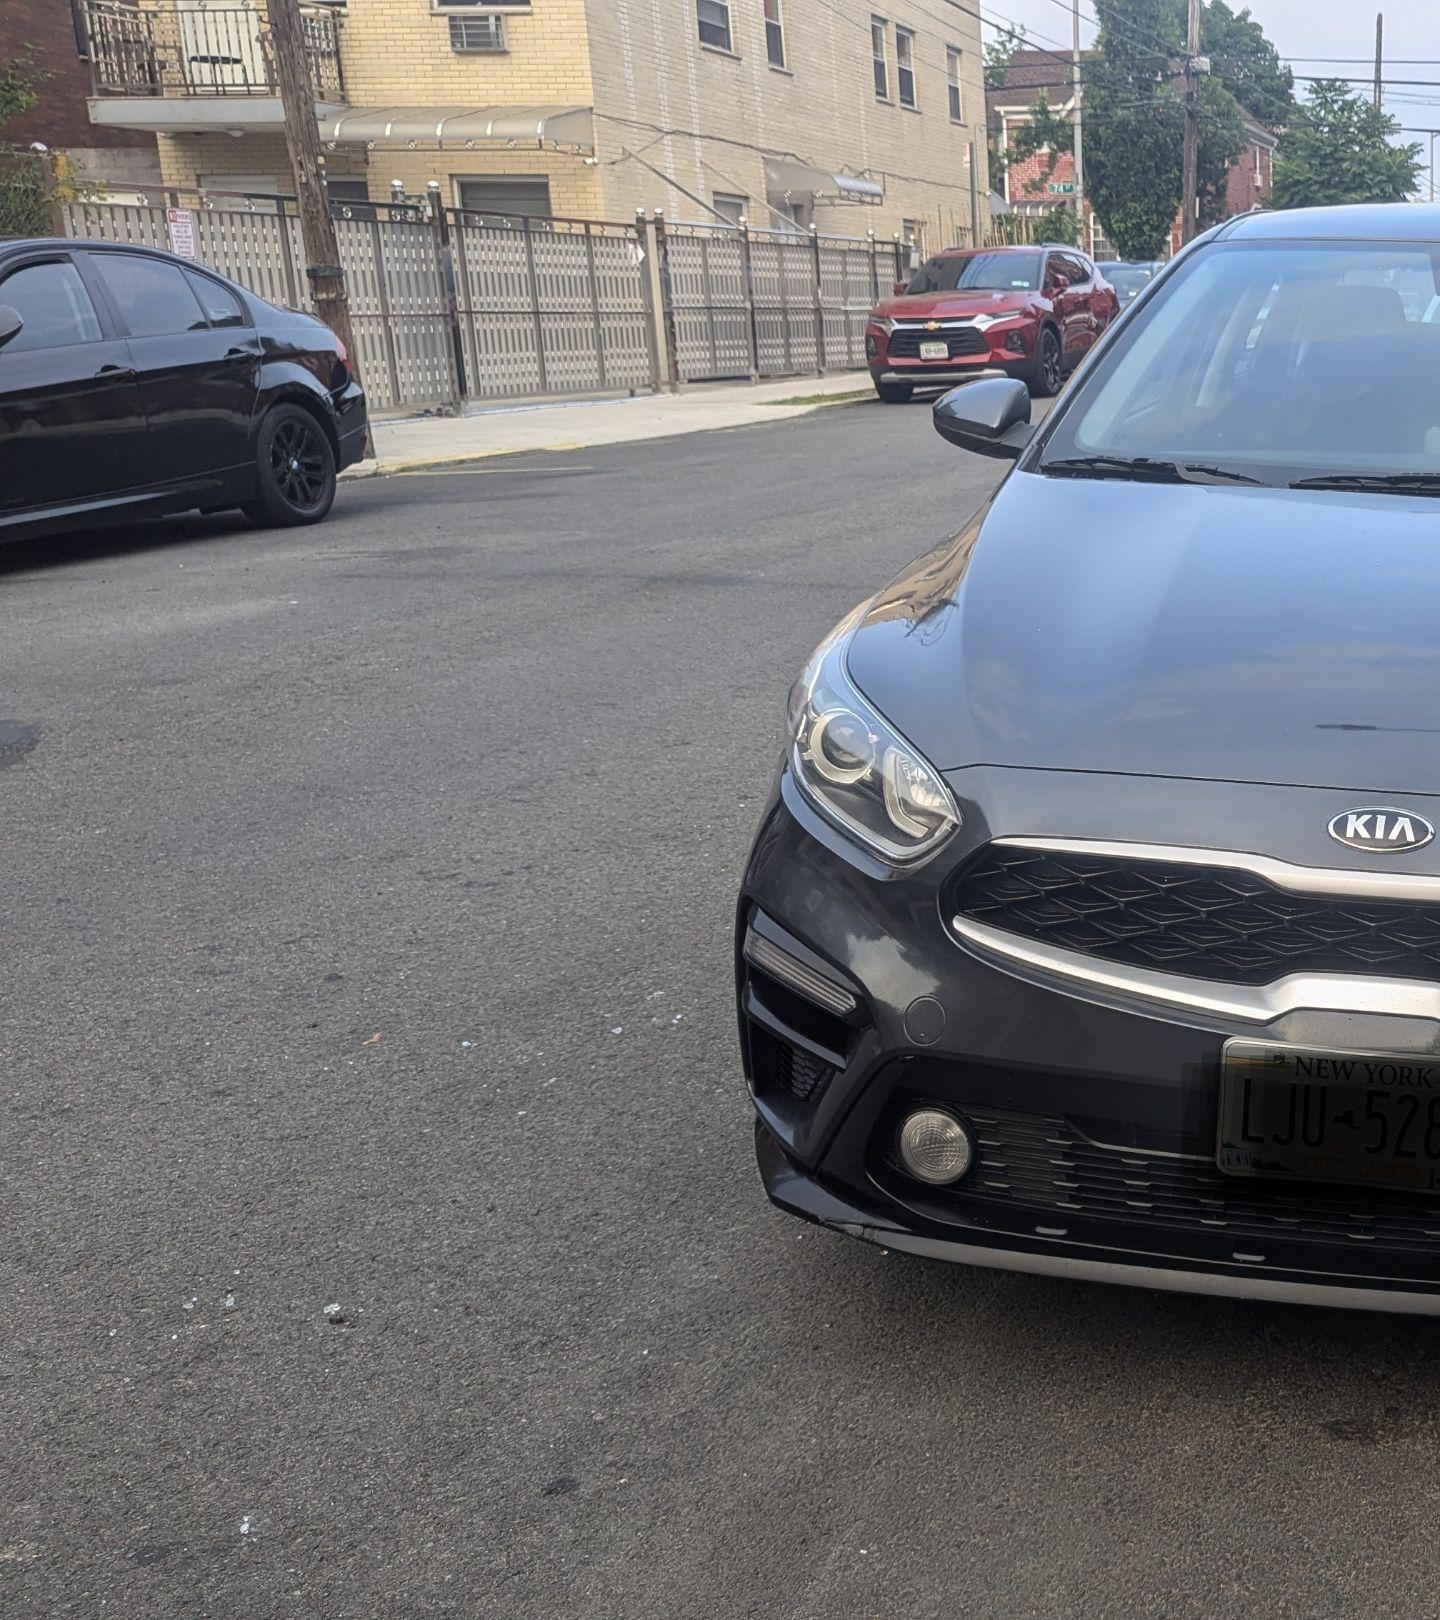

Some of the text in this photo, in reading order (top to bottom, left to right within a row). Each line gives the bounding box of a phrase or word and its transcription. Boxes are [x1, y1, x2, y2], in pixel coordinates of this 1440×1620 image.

[1345, 814, 1416, 842] KIA
[1294, 1055, 1436, 1090] NEW YORK
[1241, 1078, 1328, 1148] LJU
